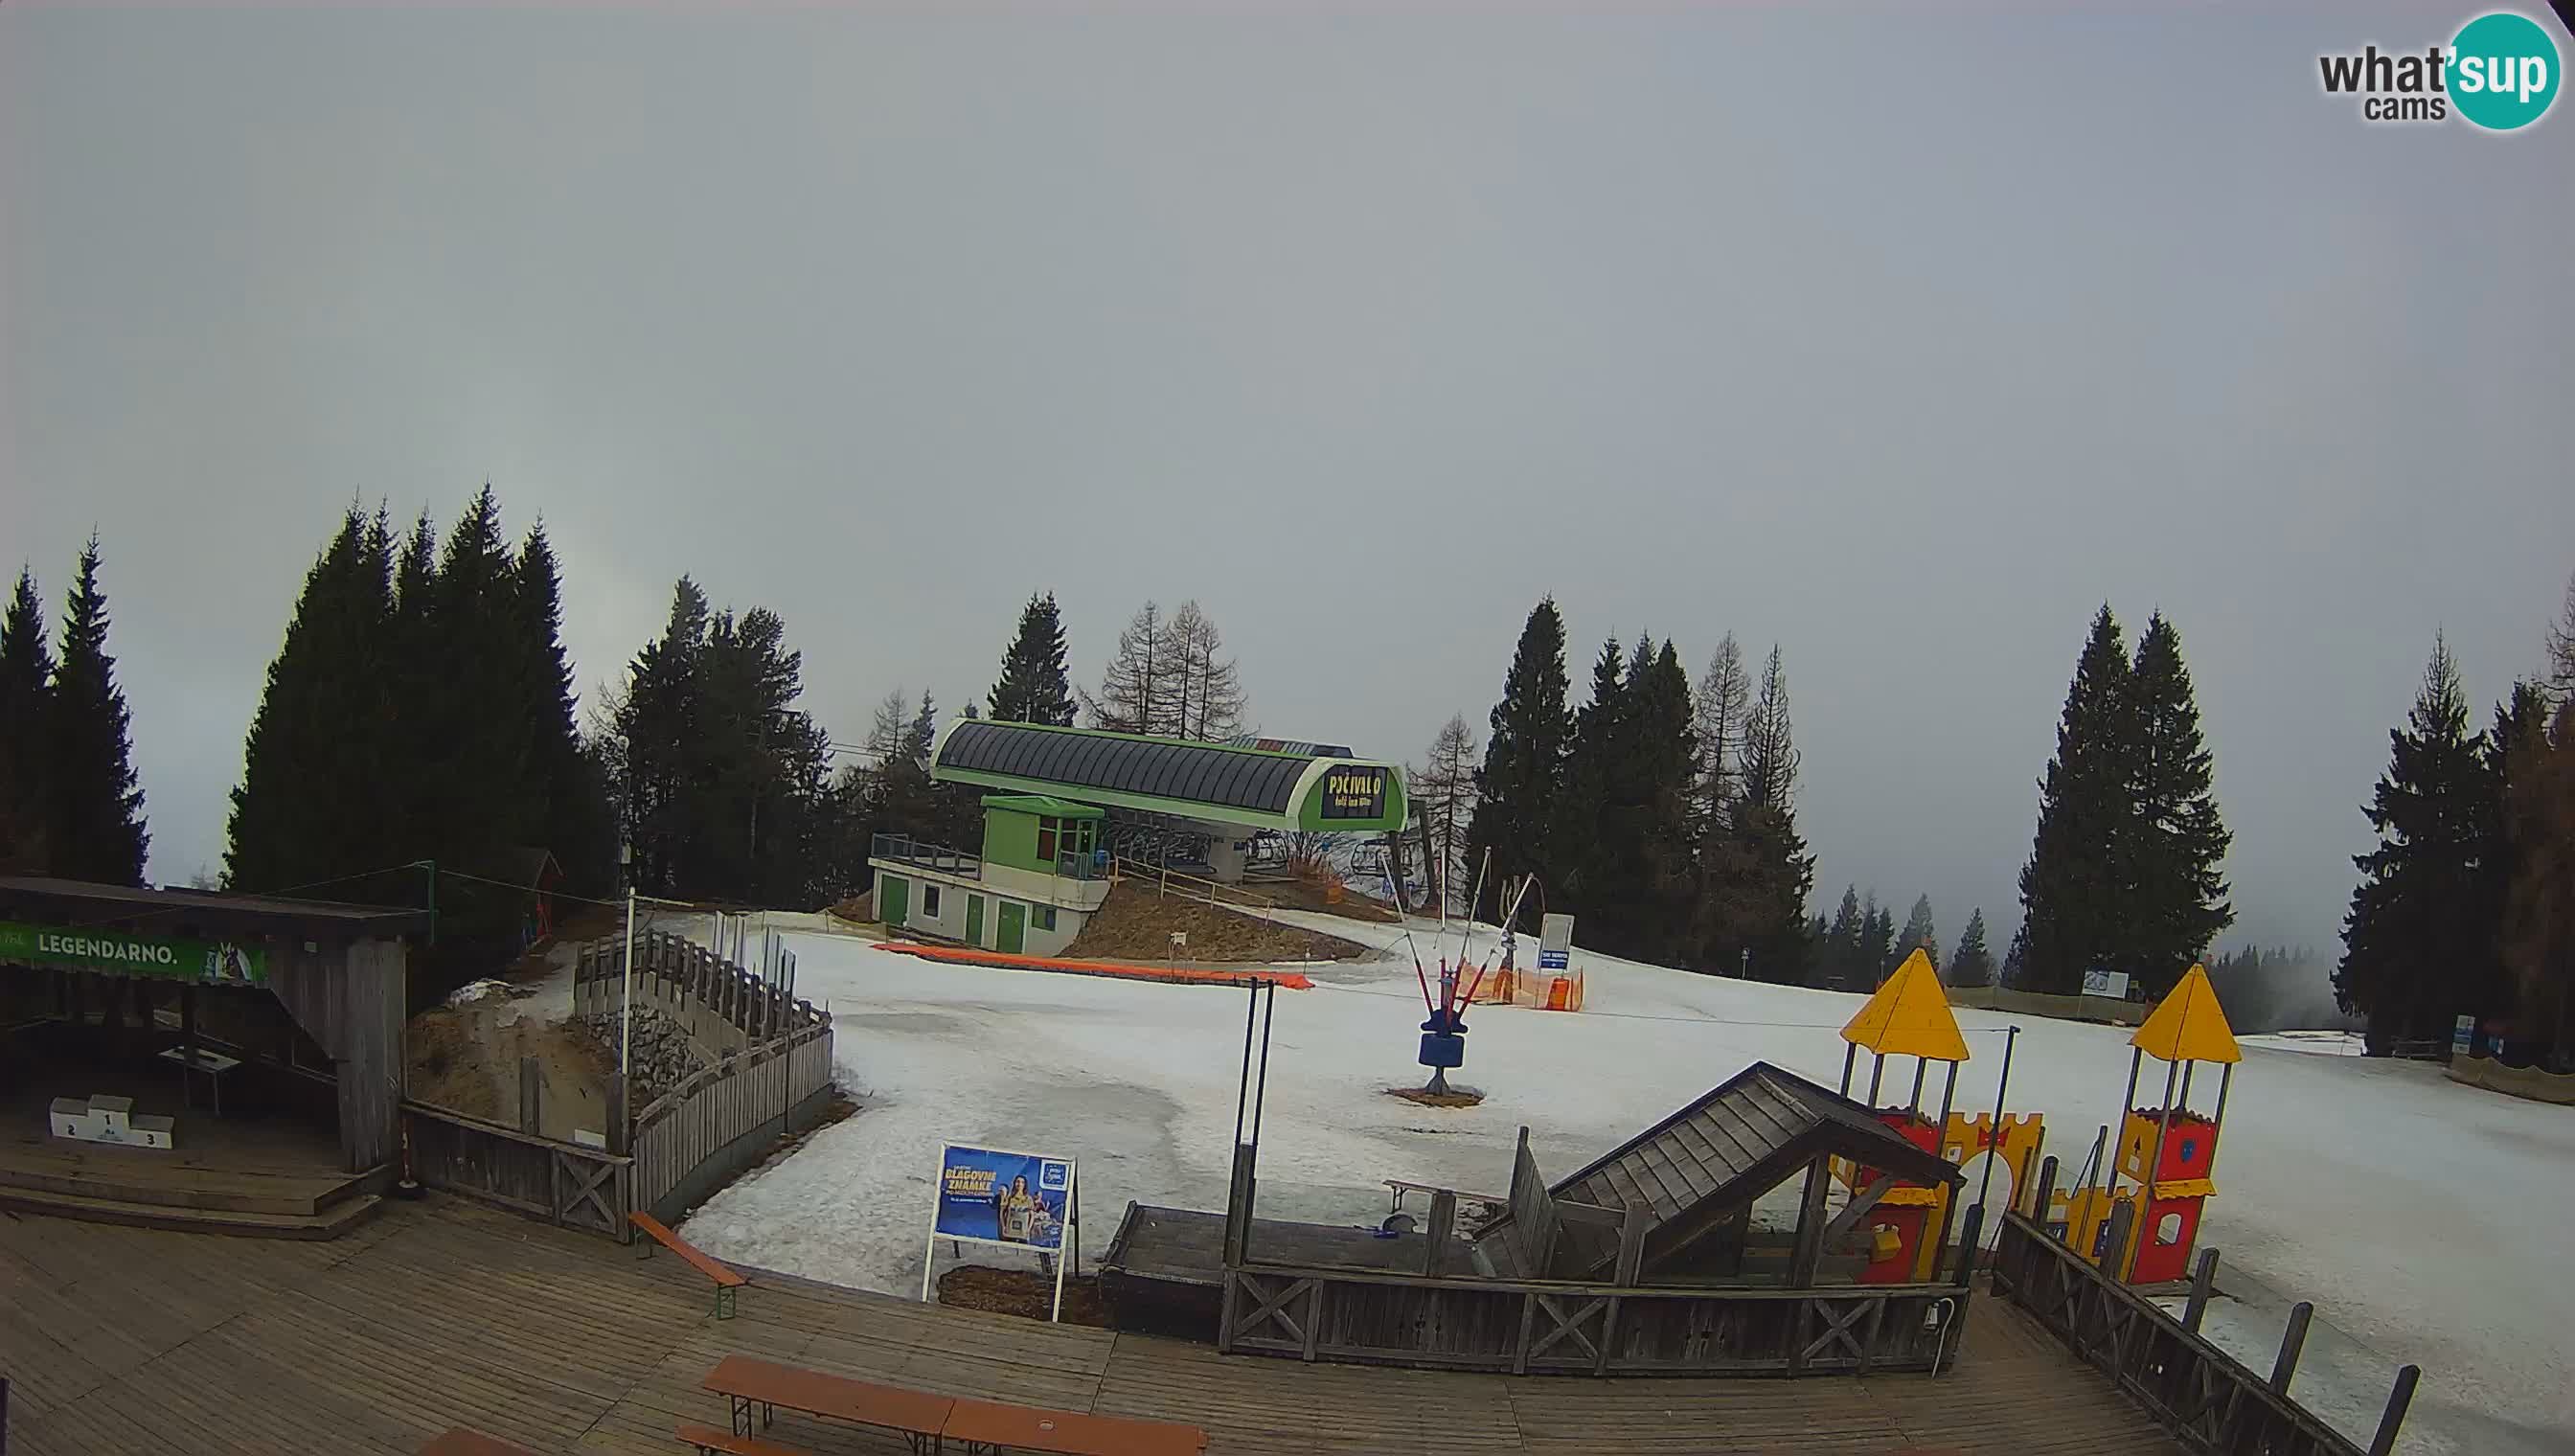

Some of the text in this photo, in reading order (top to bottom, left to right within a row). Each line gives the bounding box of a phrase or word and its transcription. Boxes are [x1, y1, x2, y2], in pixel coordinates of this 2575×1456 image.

[38, 934, 178, 965] LEGENDARNO.
[104, 1114, 111, 1126] 1
[147, 1133, 155, 1146] 3
[945, 1169, 997, 1182] BLAGOVNE
[948, 1179, 993, 1192] ZNAMKE
